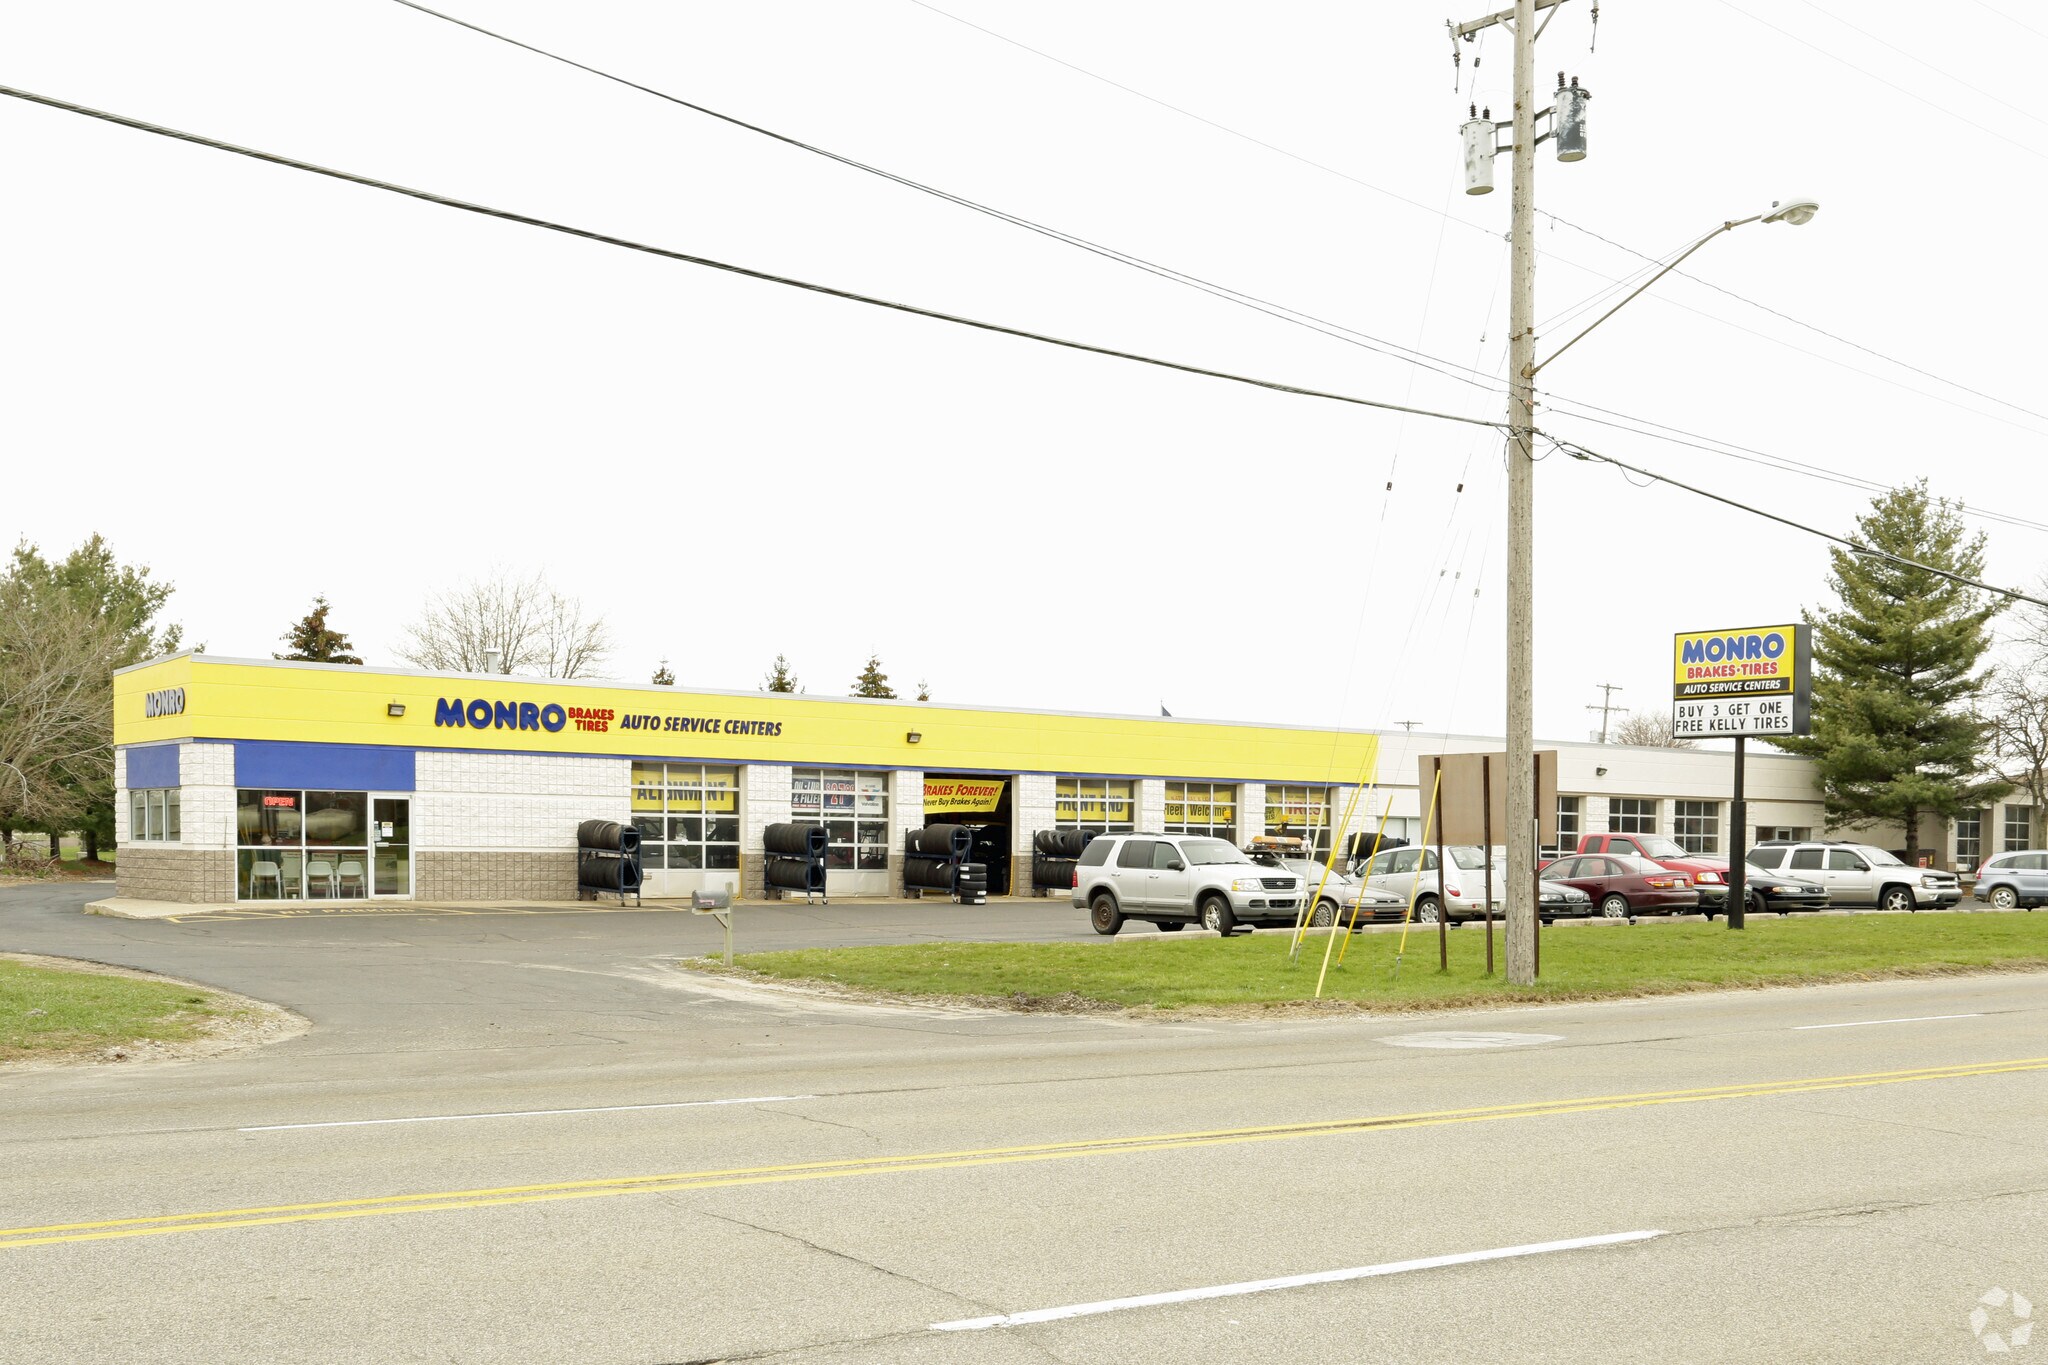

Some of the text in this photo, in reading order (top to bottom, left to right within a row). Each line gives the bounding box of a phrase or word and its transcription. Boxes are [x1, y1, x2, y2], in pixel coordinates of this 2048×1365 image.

[1681, 633, 1785, 665] MONRO
[1683, 680, 1781, 694] AUTO SERVICE CENTERS
[146, 687, 185, 718] MONRO
[1679, 701, 1782, 718] BUY 3 GET ONE
[435, 697, 567, 733] MONRO
[568, 707, 614, 720] BRAKES
[575, 719, 608, 732] TIRES
[620, 714, 782, 736] AUTO SERVICE CENTERS
[1675, 716, 1788, 732] FREE KELLY TIRES
[956, 784, 998, 796] FOREVER!
[264, 796, 293, 806] OPEN
[938, 798, 950, 807] Buy
[971, 798, 992, 807] Again!
[1056, 793, 1123, 812] FRONT END
[1165, 804, 1226, 816] leet Welcme
